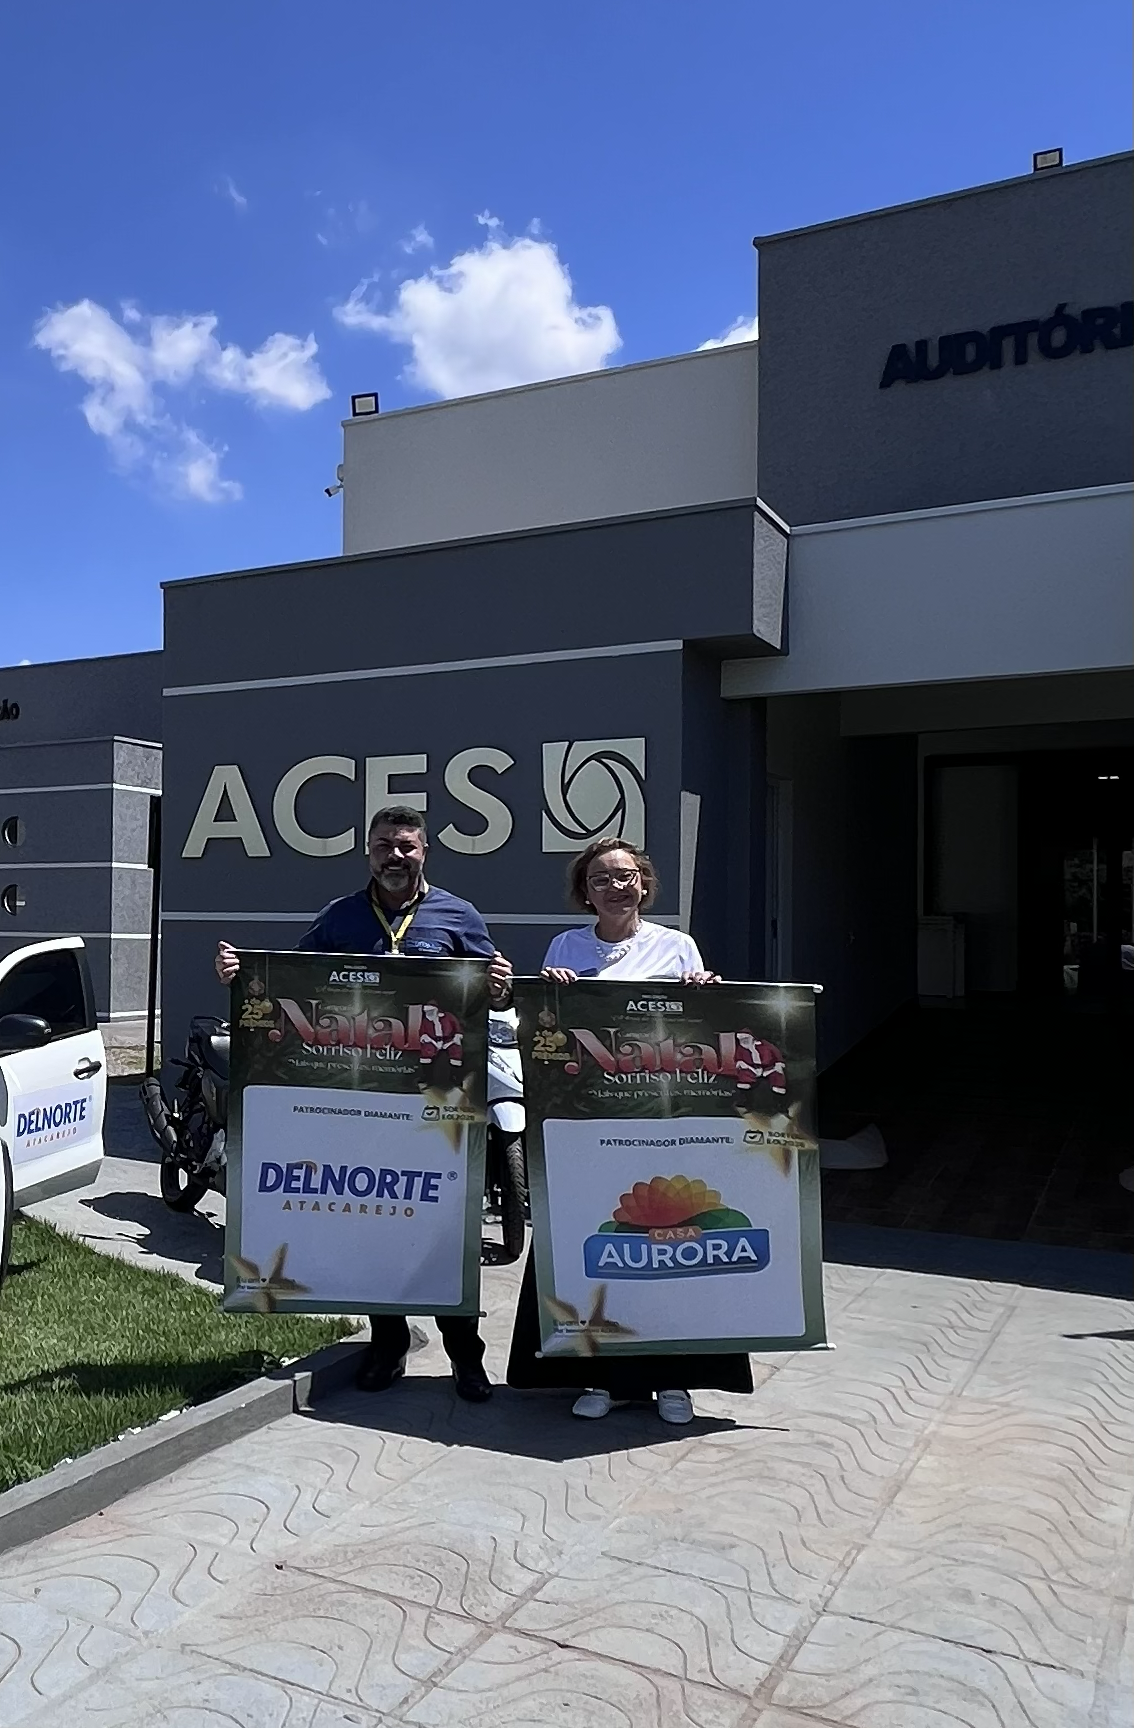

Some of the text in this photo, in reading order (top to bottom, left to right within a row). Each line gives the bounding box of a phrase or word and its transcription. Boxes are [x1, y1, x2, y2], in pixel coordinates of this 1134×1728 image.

[181, 747, 516, 858] ACES
[329, 971, 364, 983] ACES
[241, 1003, 265, 1020] 25
[626, 1000, 666, 1012] ACES
[268, 997, 422, 1049] Natal
[301, 1041, 363, 1058] Sorriso
[533, 1037, 559, 1052] 25
[564, 1027, 737, 1076] Natal
[603, 1069, 671, 1084] Sorriso
[16, 1097, 87, 1137] DELNORTE
[293, 1105, 362, 1117] PATROCINADOR
[600, 1138, 677, 1148] PATROCINADOR
[258, 1161, 442, 1203] DELNORTE
[282, 1200, 415, 1218] ATACAREJO
[653, 1228, 697, 1241] CASA
[598, 1238, 758, 1268] AURORA
